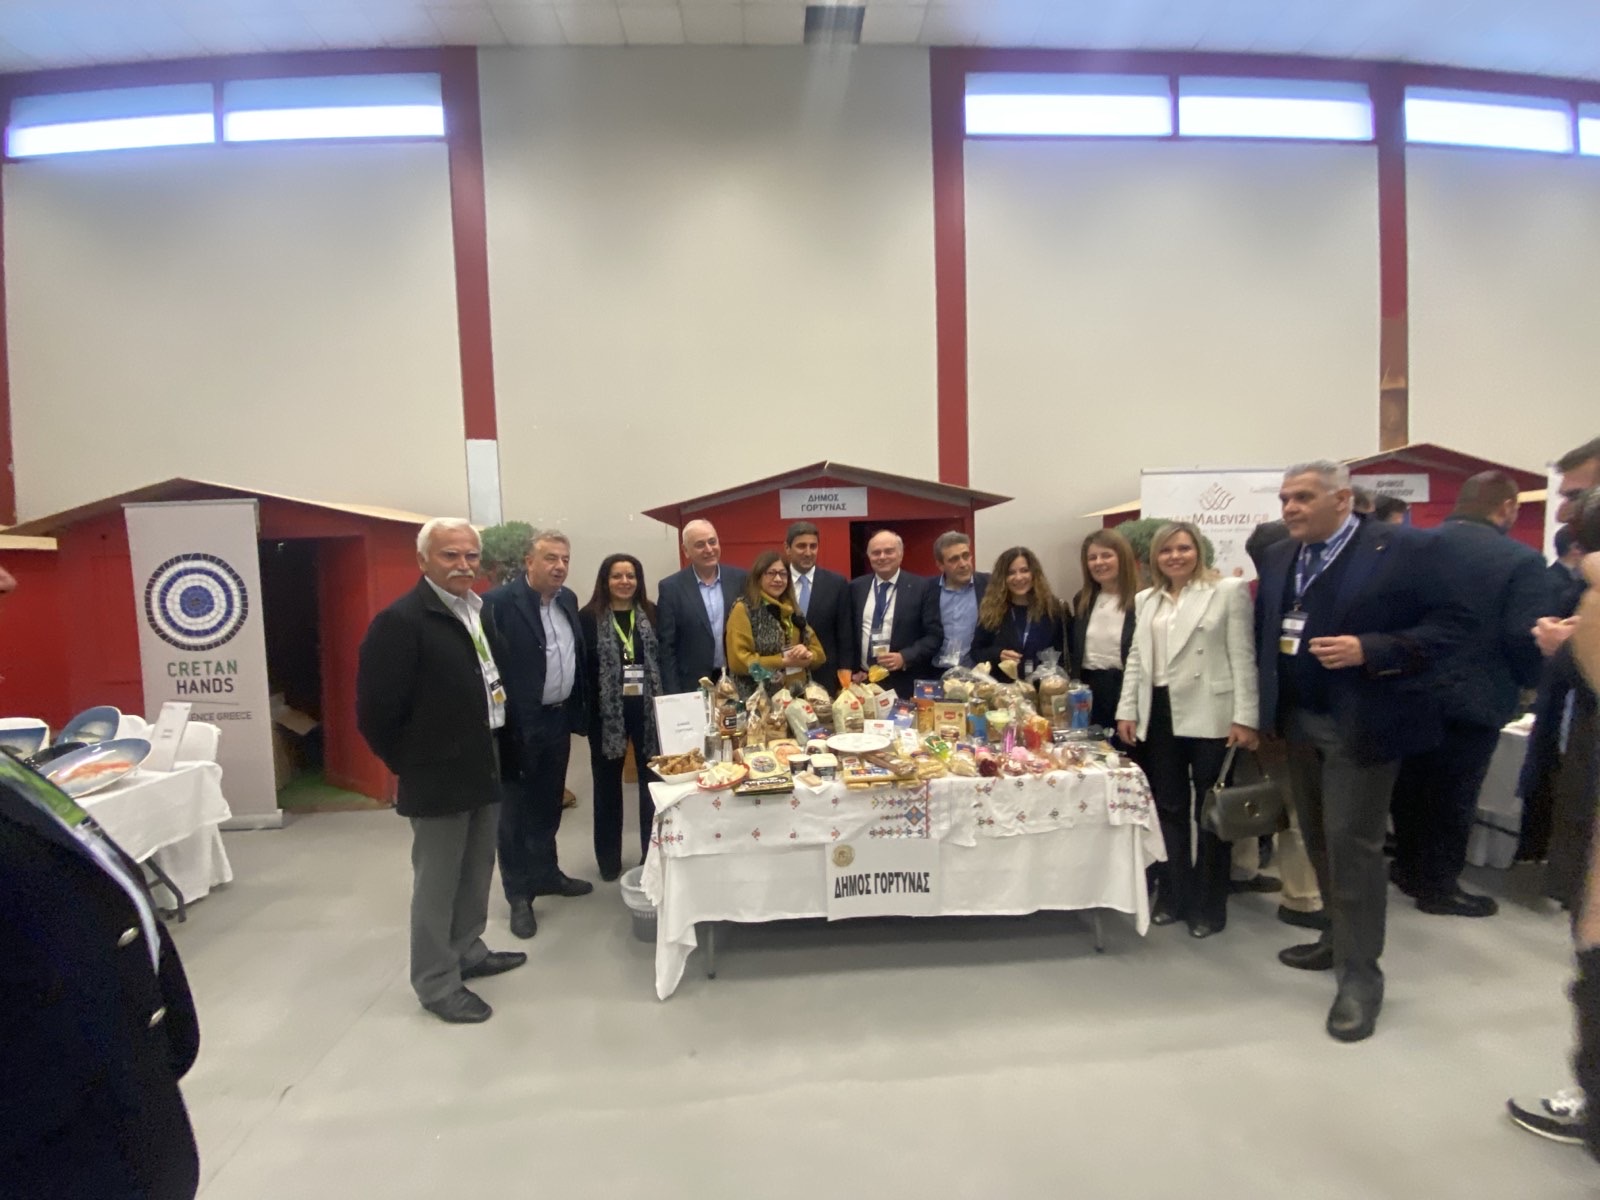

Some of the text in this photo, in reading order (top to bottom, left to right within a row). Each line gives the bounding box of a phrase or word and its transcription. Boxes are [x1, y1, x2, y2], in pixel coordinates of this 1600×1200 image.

[808, 493, 839, 503] ΔΗΜΟΣ
[801, 503, 847, 512] ΓΟΡΤΥΝΑΣ
[167, 660, 238, 677] CRETAN
[176, 677, 234, 695] HANDS
[216, 711, 252, 721] GREECE
[834, 871, 930, 899] ΔΗΜΟΣ ΓΟΡΤΥΝΑΣ
